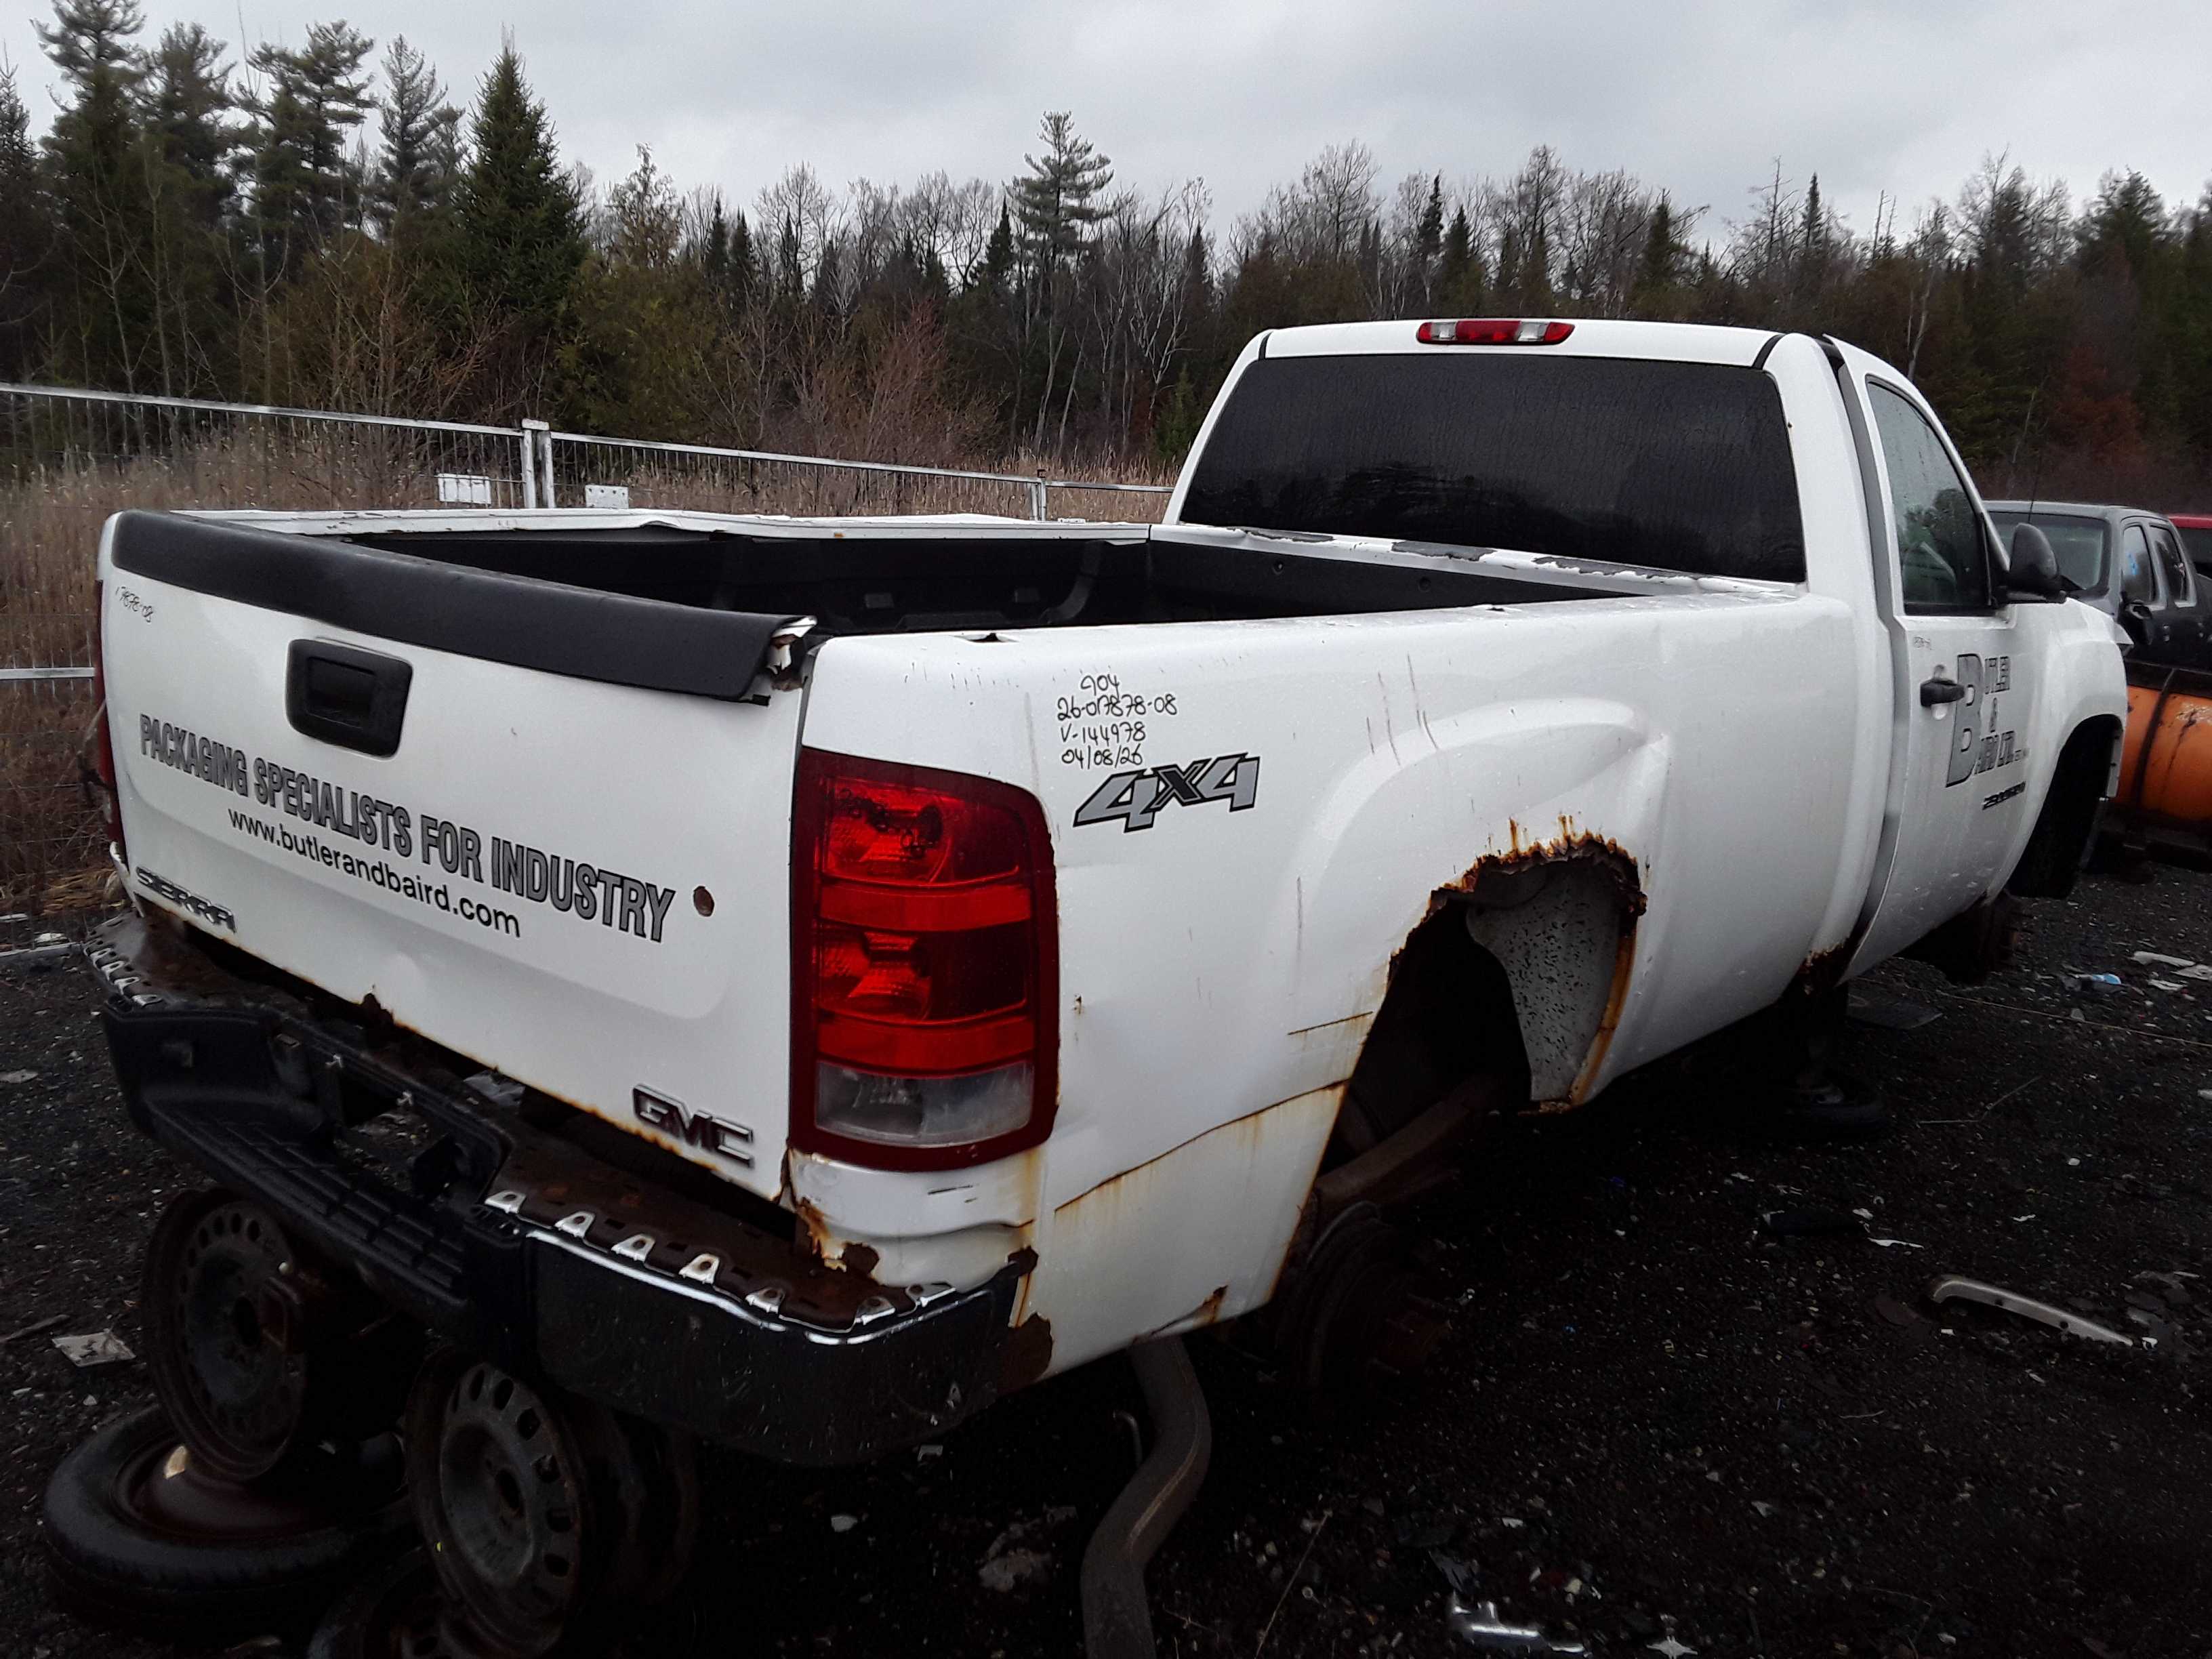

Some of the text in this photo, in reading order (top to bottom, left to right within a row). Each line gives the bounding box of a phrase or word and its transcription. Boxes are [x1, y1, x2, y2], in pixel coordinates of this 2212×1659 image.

[1080, 674, 1120, 699] 904
[1057, 693, 1177, 721] 26-017878-08
[1061, 720, 1146, 747] V-144978
[1062, 743, 1143, 770] 04/08/26
[140, 714, 676, 943] PACKAGING SPECIALISTS FOR INDUSTRY
[228, 808, 520, 938] www.butlerandbaird.com
[632, 1084, 754, 1169] GMC
